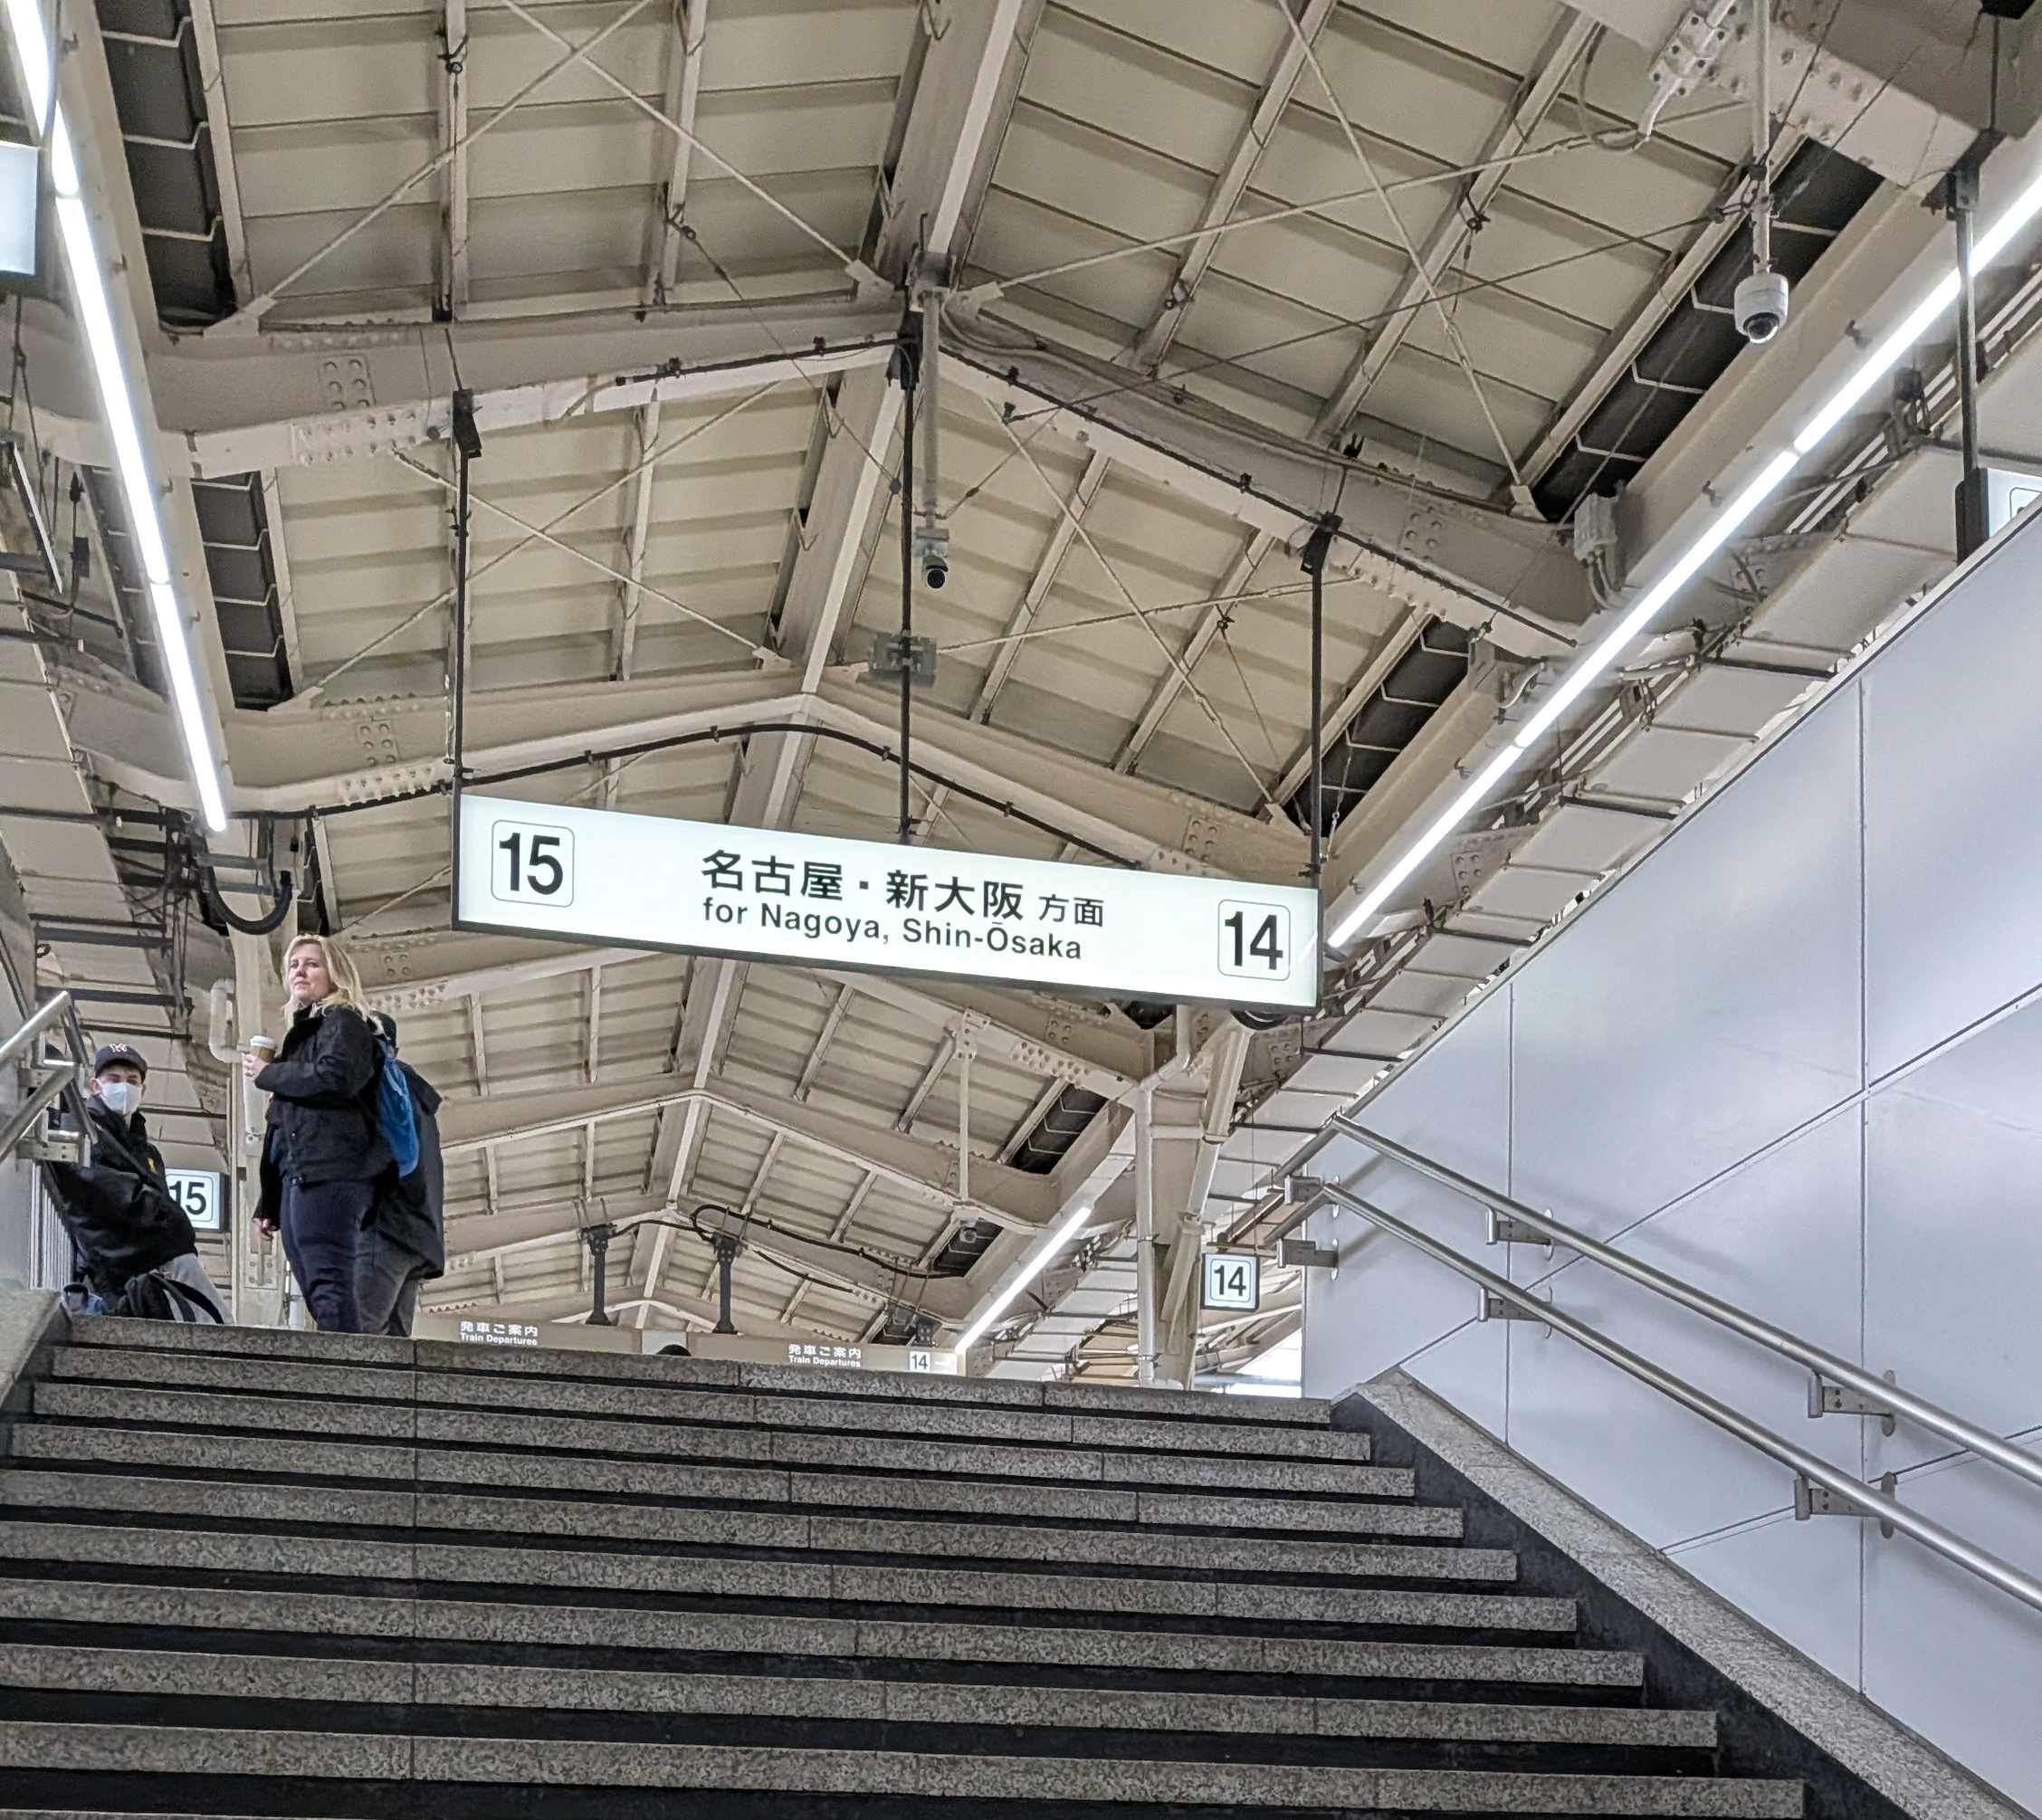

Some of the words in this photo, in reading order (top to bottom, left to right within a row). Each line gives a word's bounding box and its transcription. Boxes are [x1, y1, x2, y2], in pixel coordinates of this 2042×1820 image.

[499, 832, 563, 895] 15
[702, 849, 1024, 920] 名古屋・新大阪
[1038, 893, 1104, 927] 方面
[703, 896, 749, 924] for
[760, 903, 888, 943] Nagoya,
[902, 918, 1083, 960] Shin-Ōsaka
[1225, 910, 1283, 971] 14
[169, 1180, 207, 1215] 15
[1214, 1264, 1246, 1297] 14
[461, 1321, 538, 1337] 発車ご案内
[461, 1334, 483, 1342] Train
[487, 1336, 538, 1346] Departures
[788, 1344, 861, 1359] 発車ご案内
[788, 1356, 811, 1364] Train
[814, 1358, 861, 1367] Departures
[911, 1354, 928, 1370] 14
